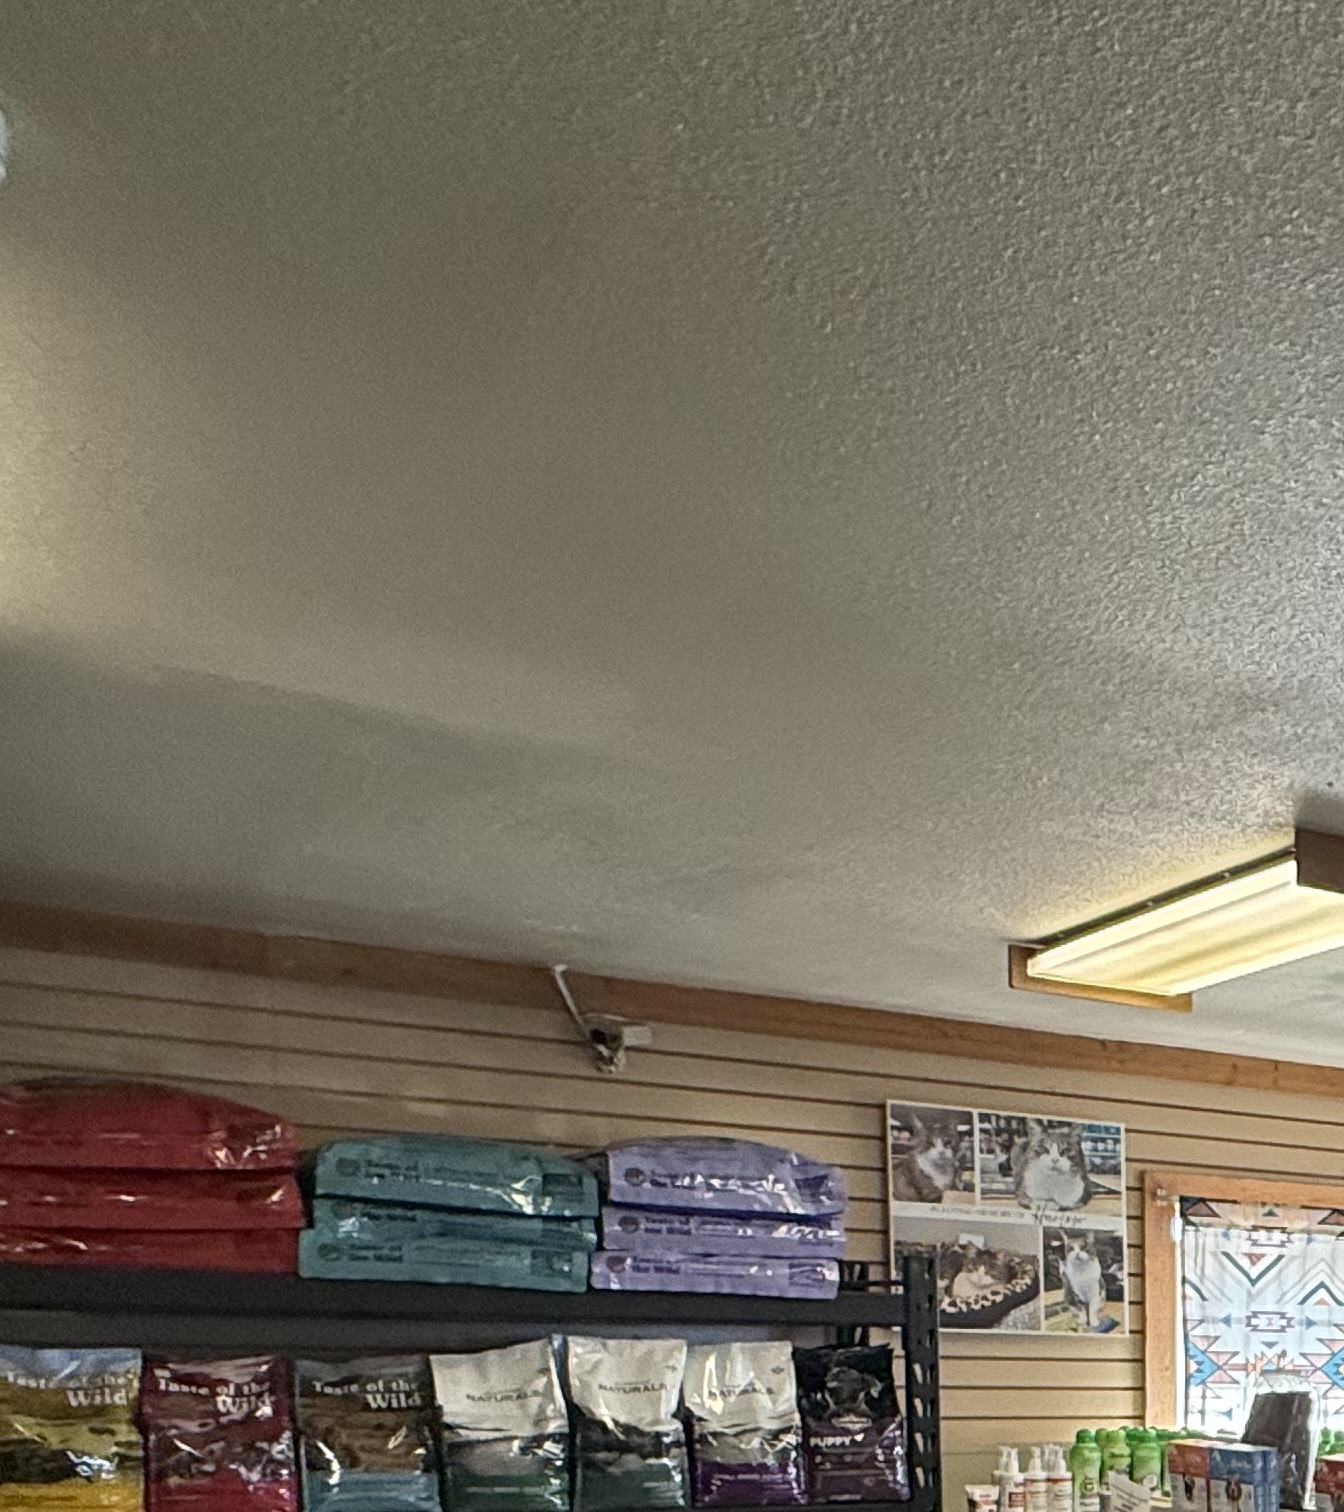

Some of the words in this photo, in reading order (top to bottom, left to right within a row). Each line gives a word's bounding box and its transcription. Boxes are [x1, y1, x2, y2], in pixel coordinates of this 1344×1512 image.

[366, 1379, 385, 1392] of
[366, 1392, 422, 1410] Wild
[809, 1434, 851, 1448] PUPPY
